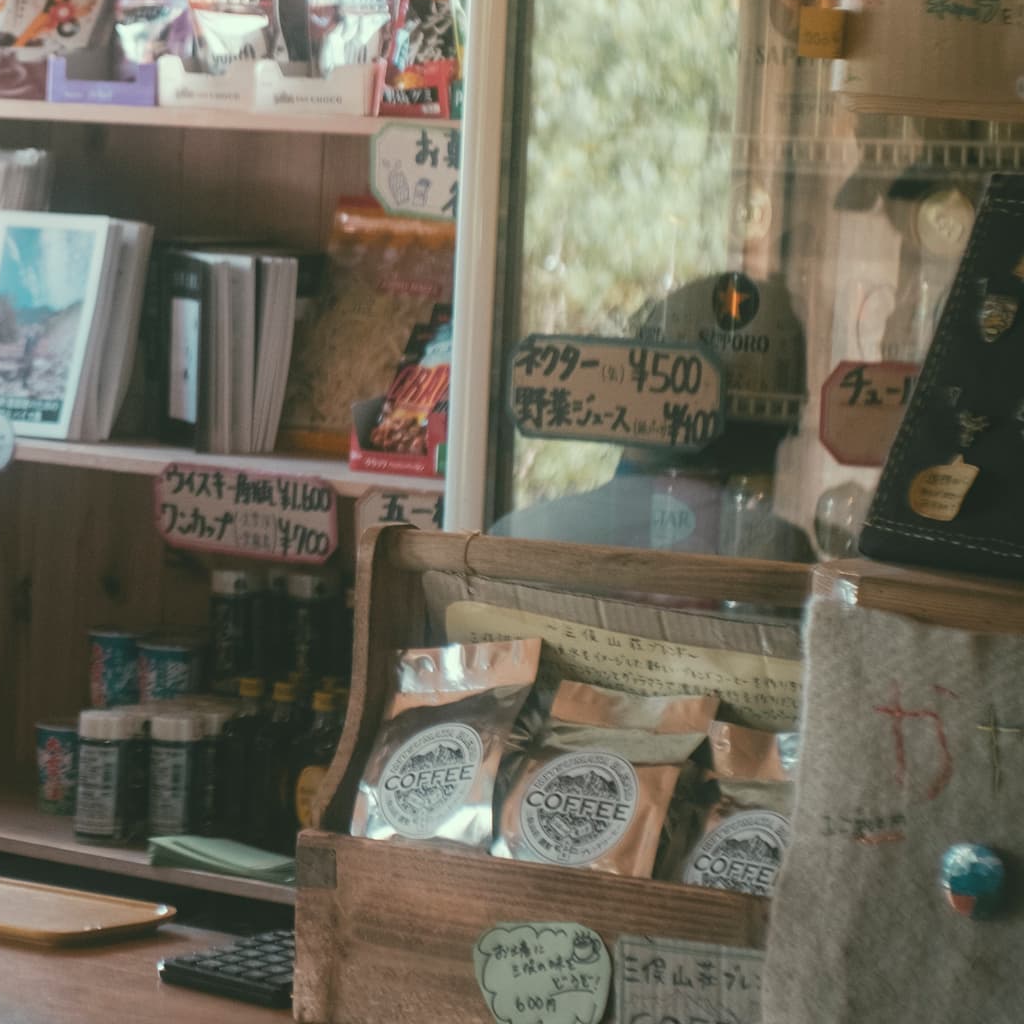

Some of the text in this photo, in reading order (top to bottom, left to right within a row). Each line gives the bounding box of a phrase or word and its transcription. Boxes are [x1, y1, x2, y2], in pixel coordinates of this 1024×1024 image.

[514, 341, 600, 381] ネクター
[629, 348, 703, 394] ¥500
[515, 386, 631, 433] 野菜ジュース
[277, 516, 329, 557] ¥700
[384, 763, 475, 791] COFFEE
[526, 790, 631, 822] COFFEE
[693, 853, 778, 886] COFFE
[515, 995, 557, 1013] 600円
